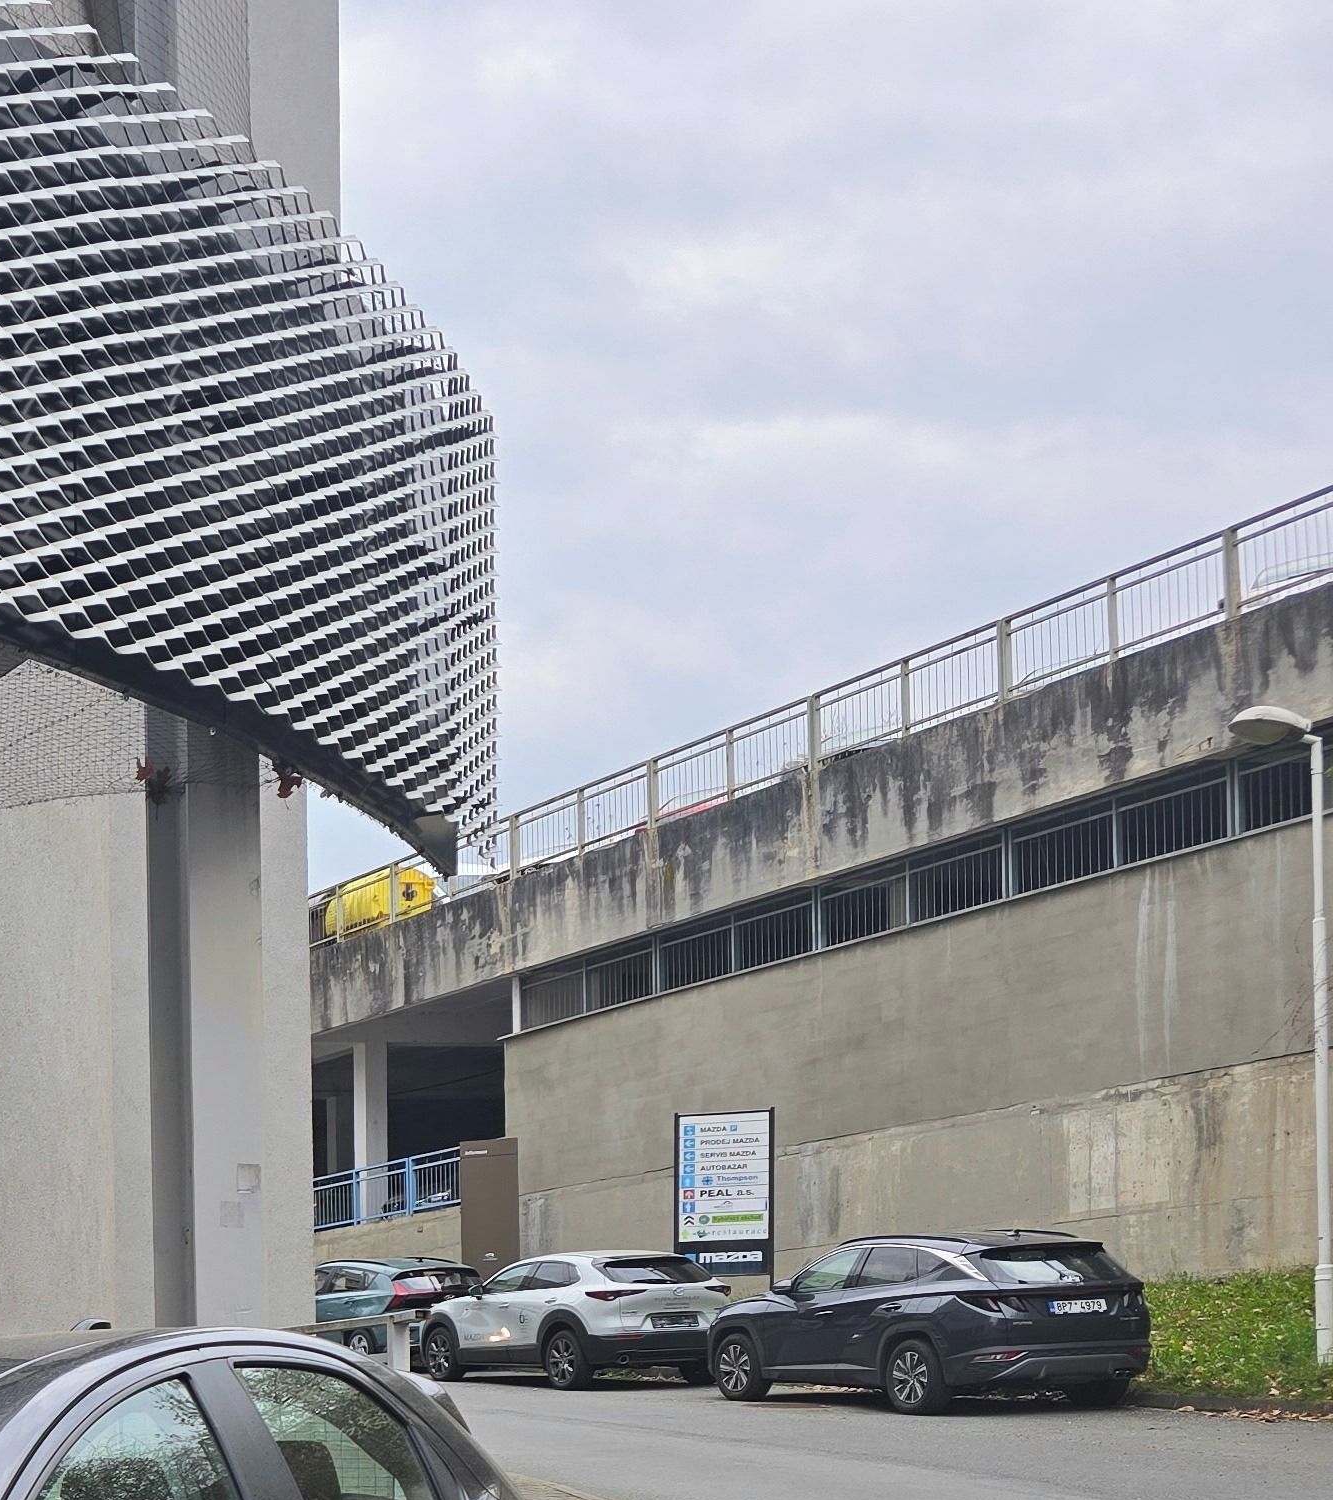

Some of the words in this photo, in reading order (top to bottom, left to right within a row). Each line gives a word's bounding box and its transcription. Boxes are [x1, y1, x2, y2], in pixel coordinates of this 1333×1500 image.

[700, 1163, 747, 1171] AUTOBAZAR
[699, 1189, 732, 1197] PEAL
[1056, 1302, 1072, 1312] 8P7
[1080, 1300, 1103, 1311] 4979
